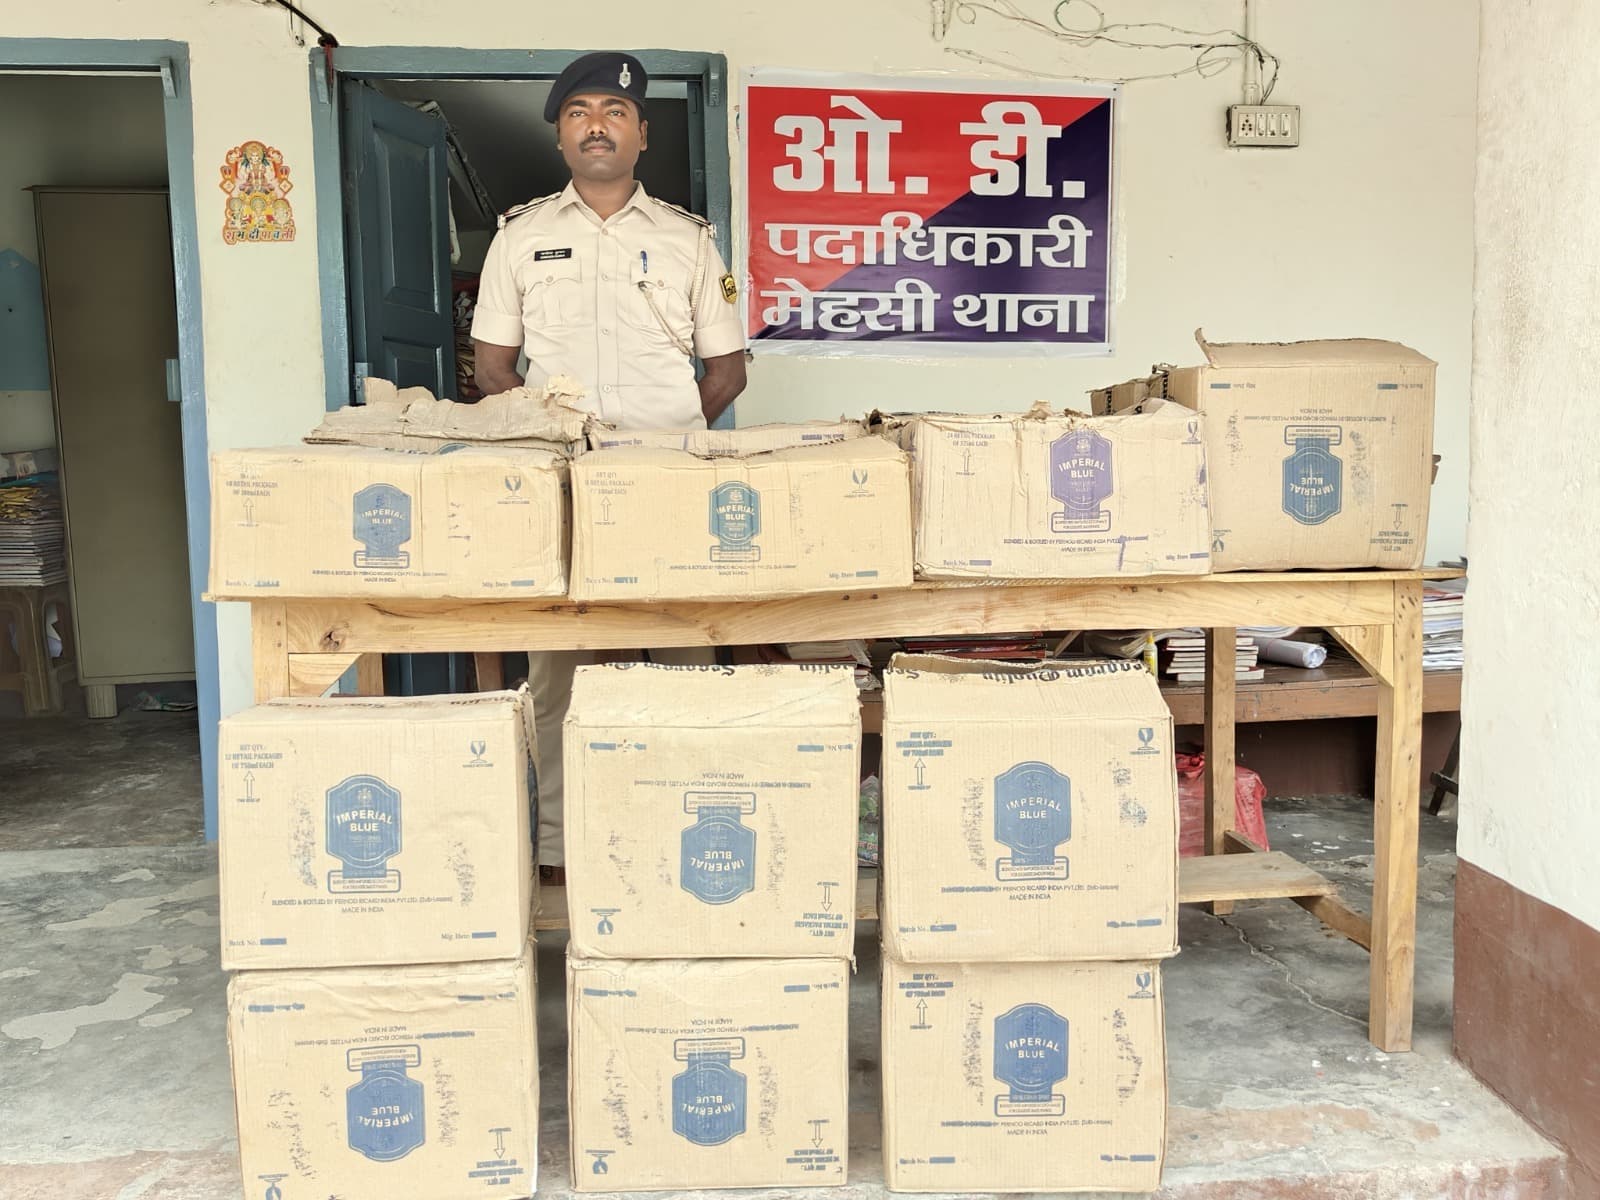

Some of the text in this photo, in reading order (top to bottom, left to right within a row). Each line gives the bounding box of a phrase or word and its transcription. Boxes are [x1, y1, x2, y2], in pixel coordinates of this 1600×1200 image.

[773, 95, 1086, 198] ओ. डी.
[764, 211, 1093, 268] पदाधिकारी
[760, 277, 1096, 333] मेहसी थाना
[1058, 457, 1105, 472] IMPERIAL
[1070, 470, 1094, 478] BLUE
[1300, 477, 1324, 486] BLUE
[1289, 482, 1334, 496] IMPERIAL
[716, 503, 756, 516] IMPERIAL
[1006, 796, 1061, 812] IMPERIAL
[336, 809, 393, 824] IMPERIAL
[1019, 810, 1047, 819] BLUE
[350, 823, 379, 832] BLUE
[704, 850, 732, 860] BLUE
[690, 856, 745, 872] IMPERIAL
[1004, 1037, 1060, 1052] IMPERIAL
[1018, 1050, 1045, 1058] BLUE
[696, 1096, 723, 1104] BLUE
[371, 1105, 400, 1116] BLUE
[682, 1102, 736, 1116] IMPERIAL
[356, 1112, 414, 1128] IMPERIAL
